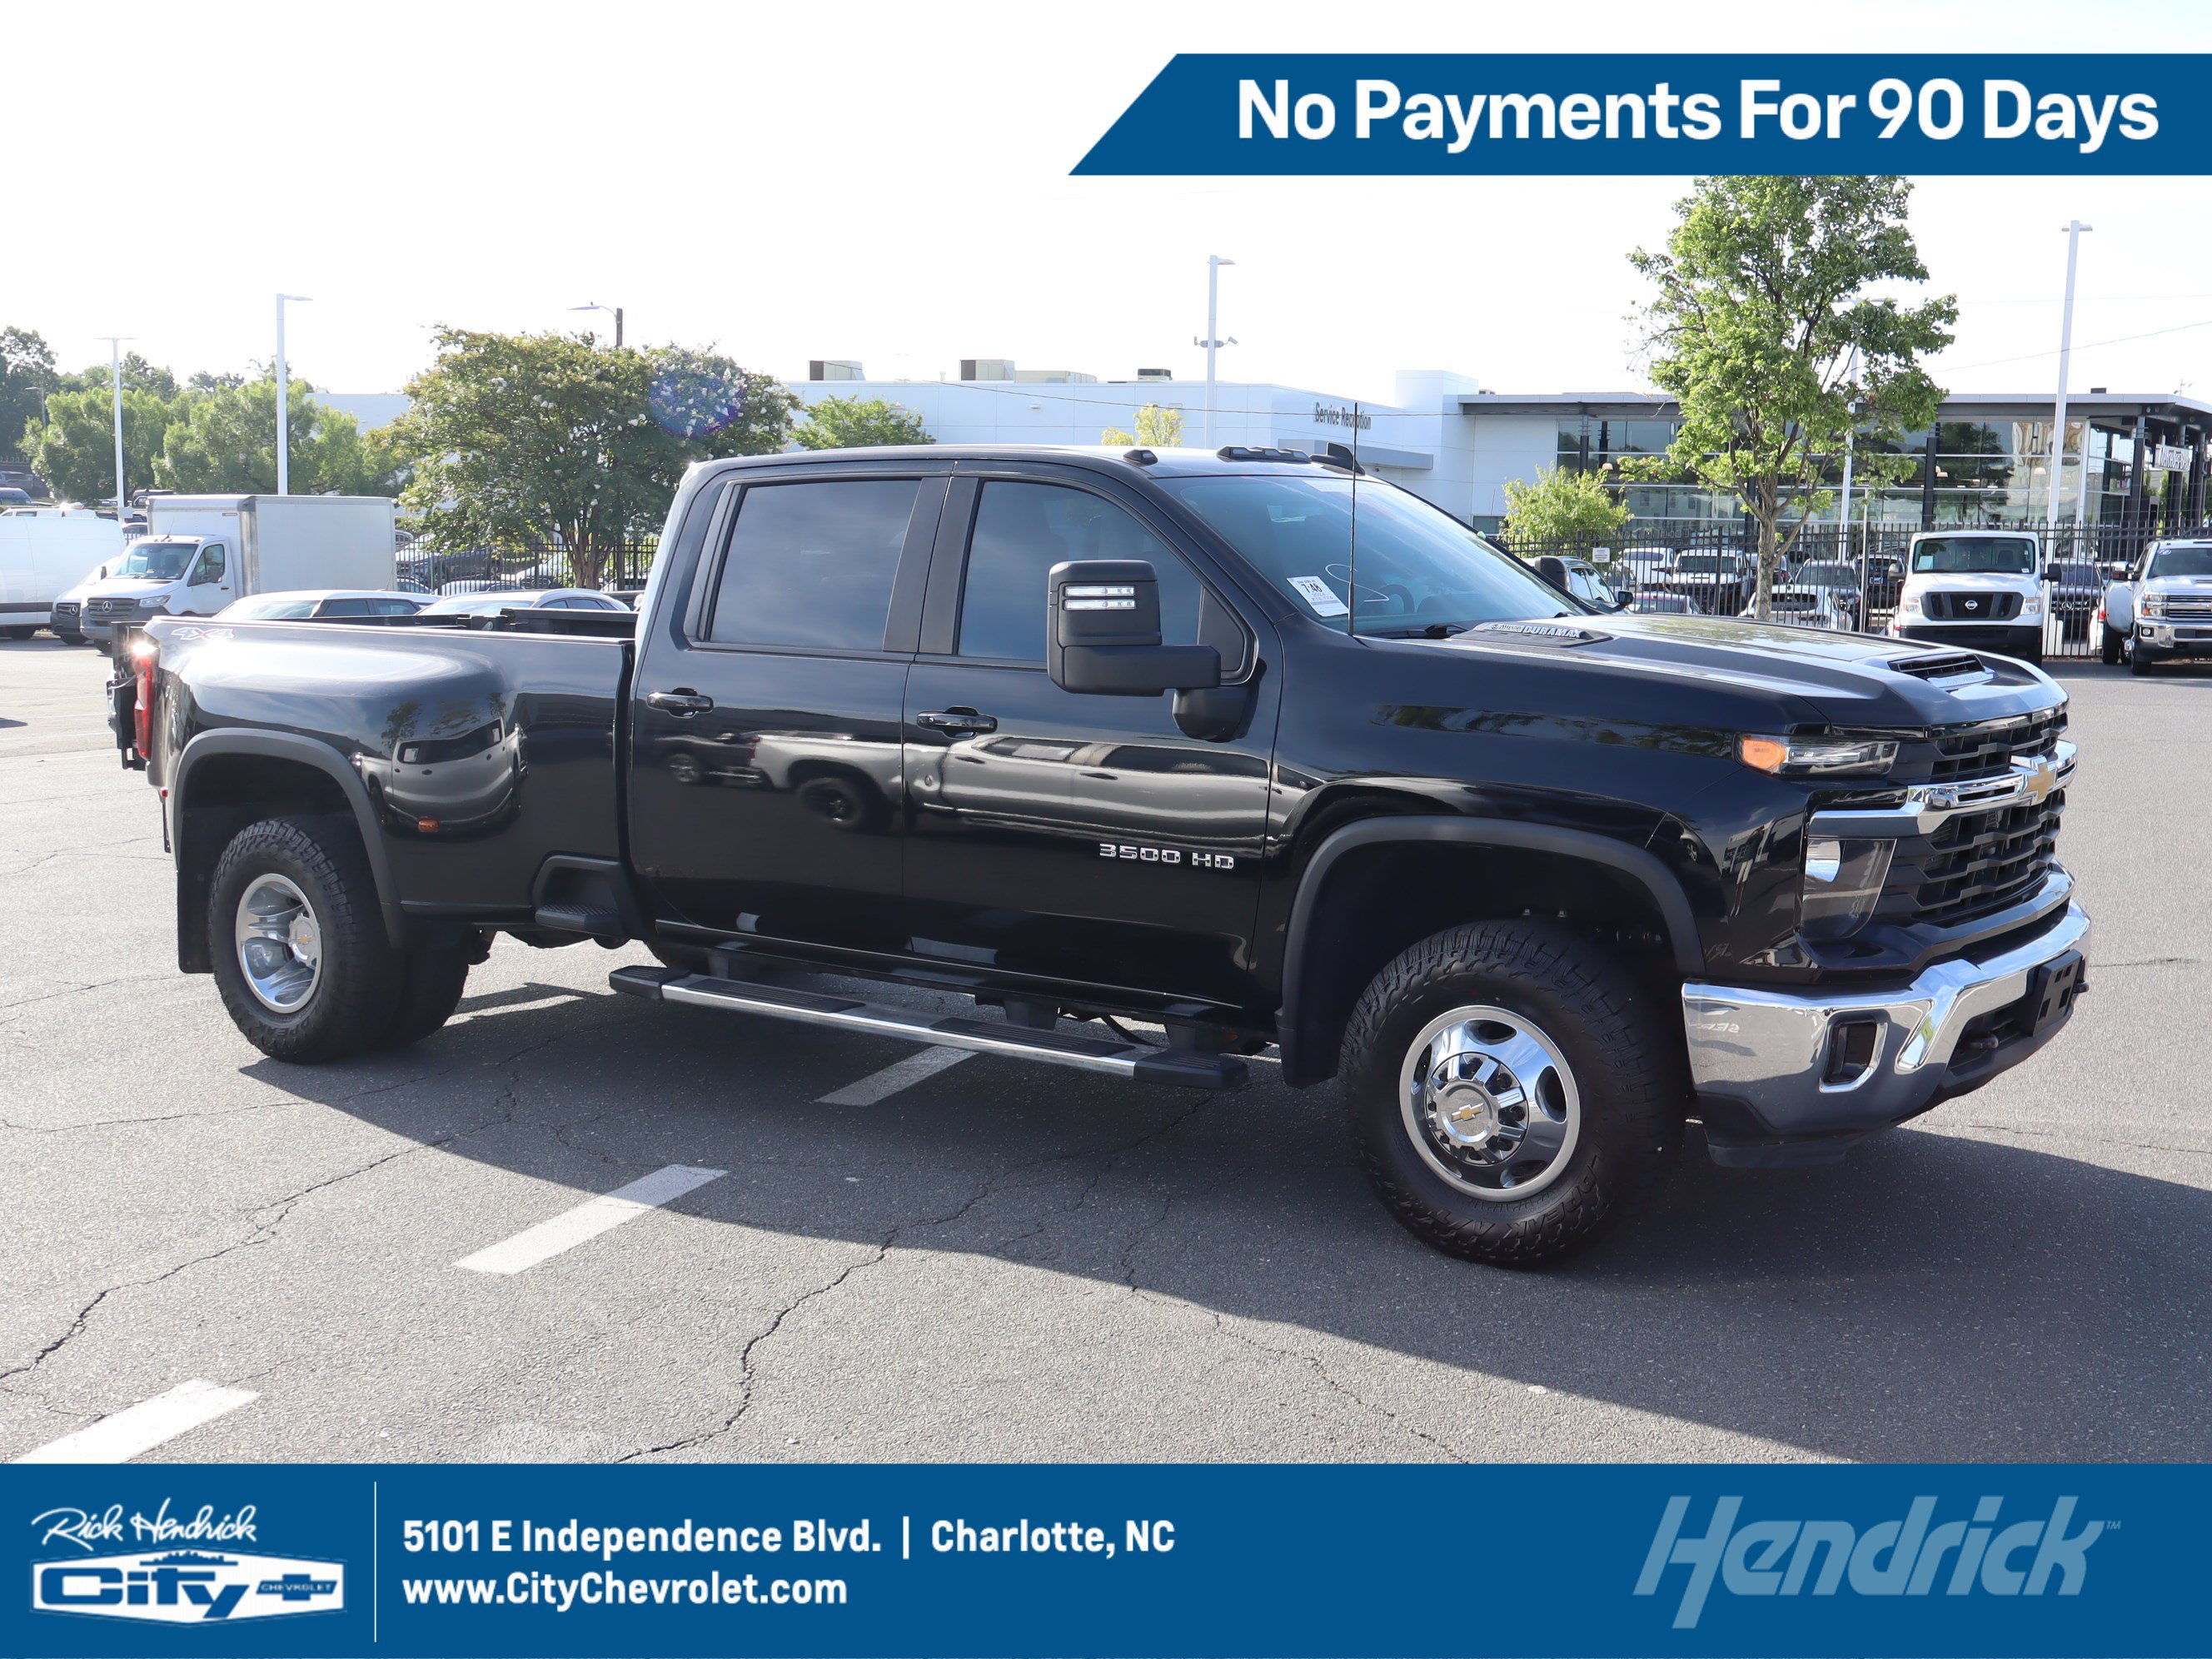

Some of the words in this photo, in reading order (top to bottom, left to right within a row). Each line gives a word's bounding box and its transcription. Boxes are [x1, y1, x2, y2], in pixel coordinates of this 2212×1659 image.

[1314, 401, 1340, 426] Service
[1524, 625, 1582, 638] DURAMAX
[1099, 843, 1181, 864] 3500
[1192, 852, 1234, 869] HD
